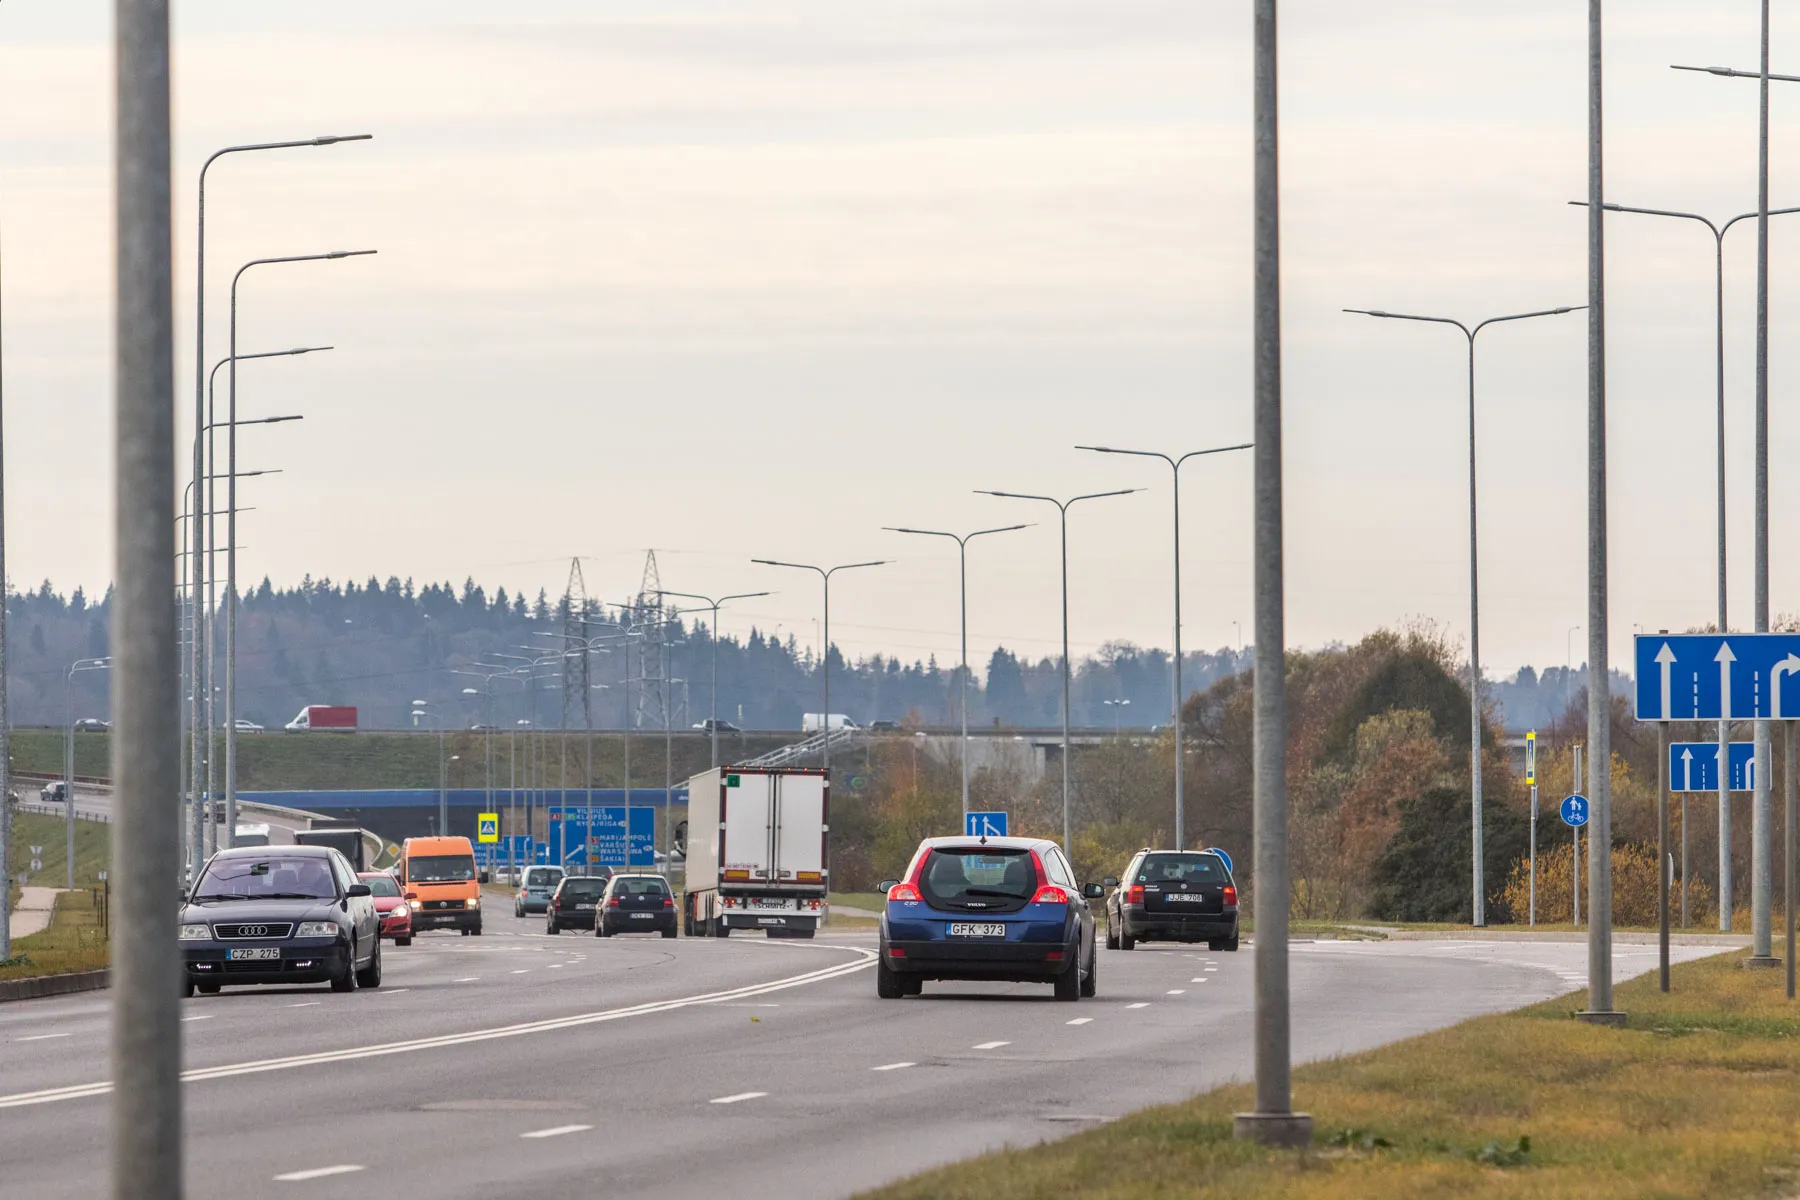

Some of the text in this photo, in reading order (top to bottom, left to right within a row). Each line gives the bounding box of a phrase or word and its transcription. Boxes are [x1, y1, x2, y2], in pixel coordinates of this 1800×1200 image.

[952, 924, 1004, 935] GFK 373
[232, 949, 279, 959] CZP 275
